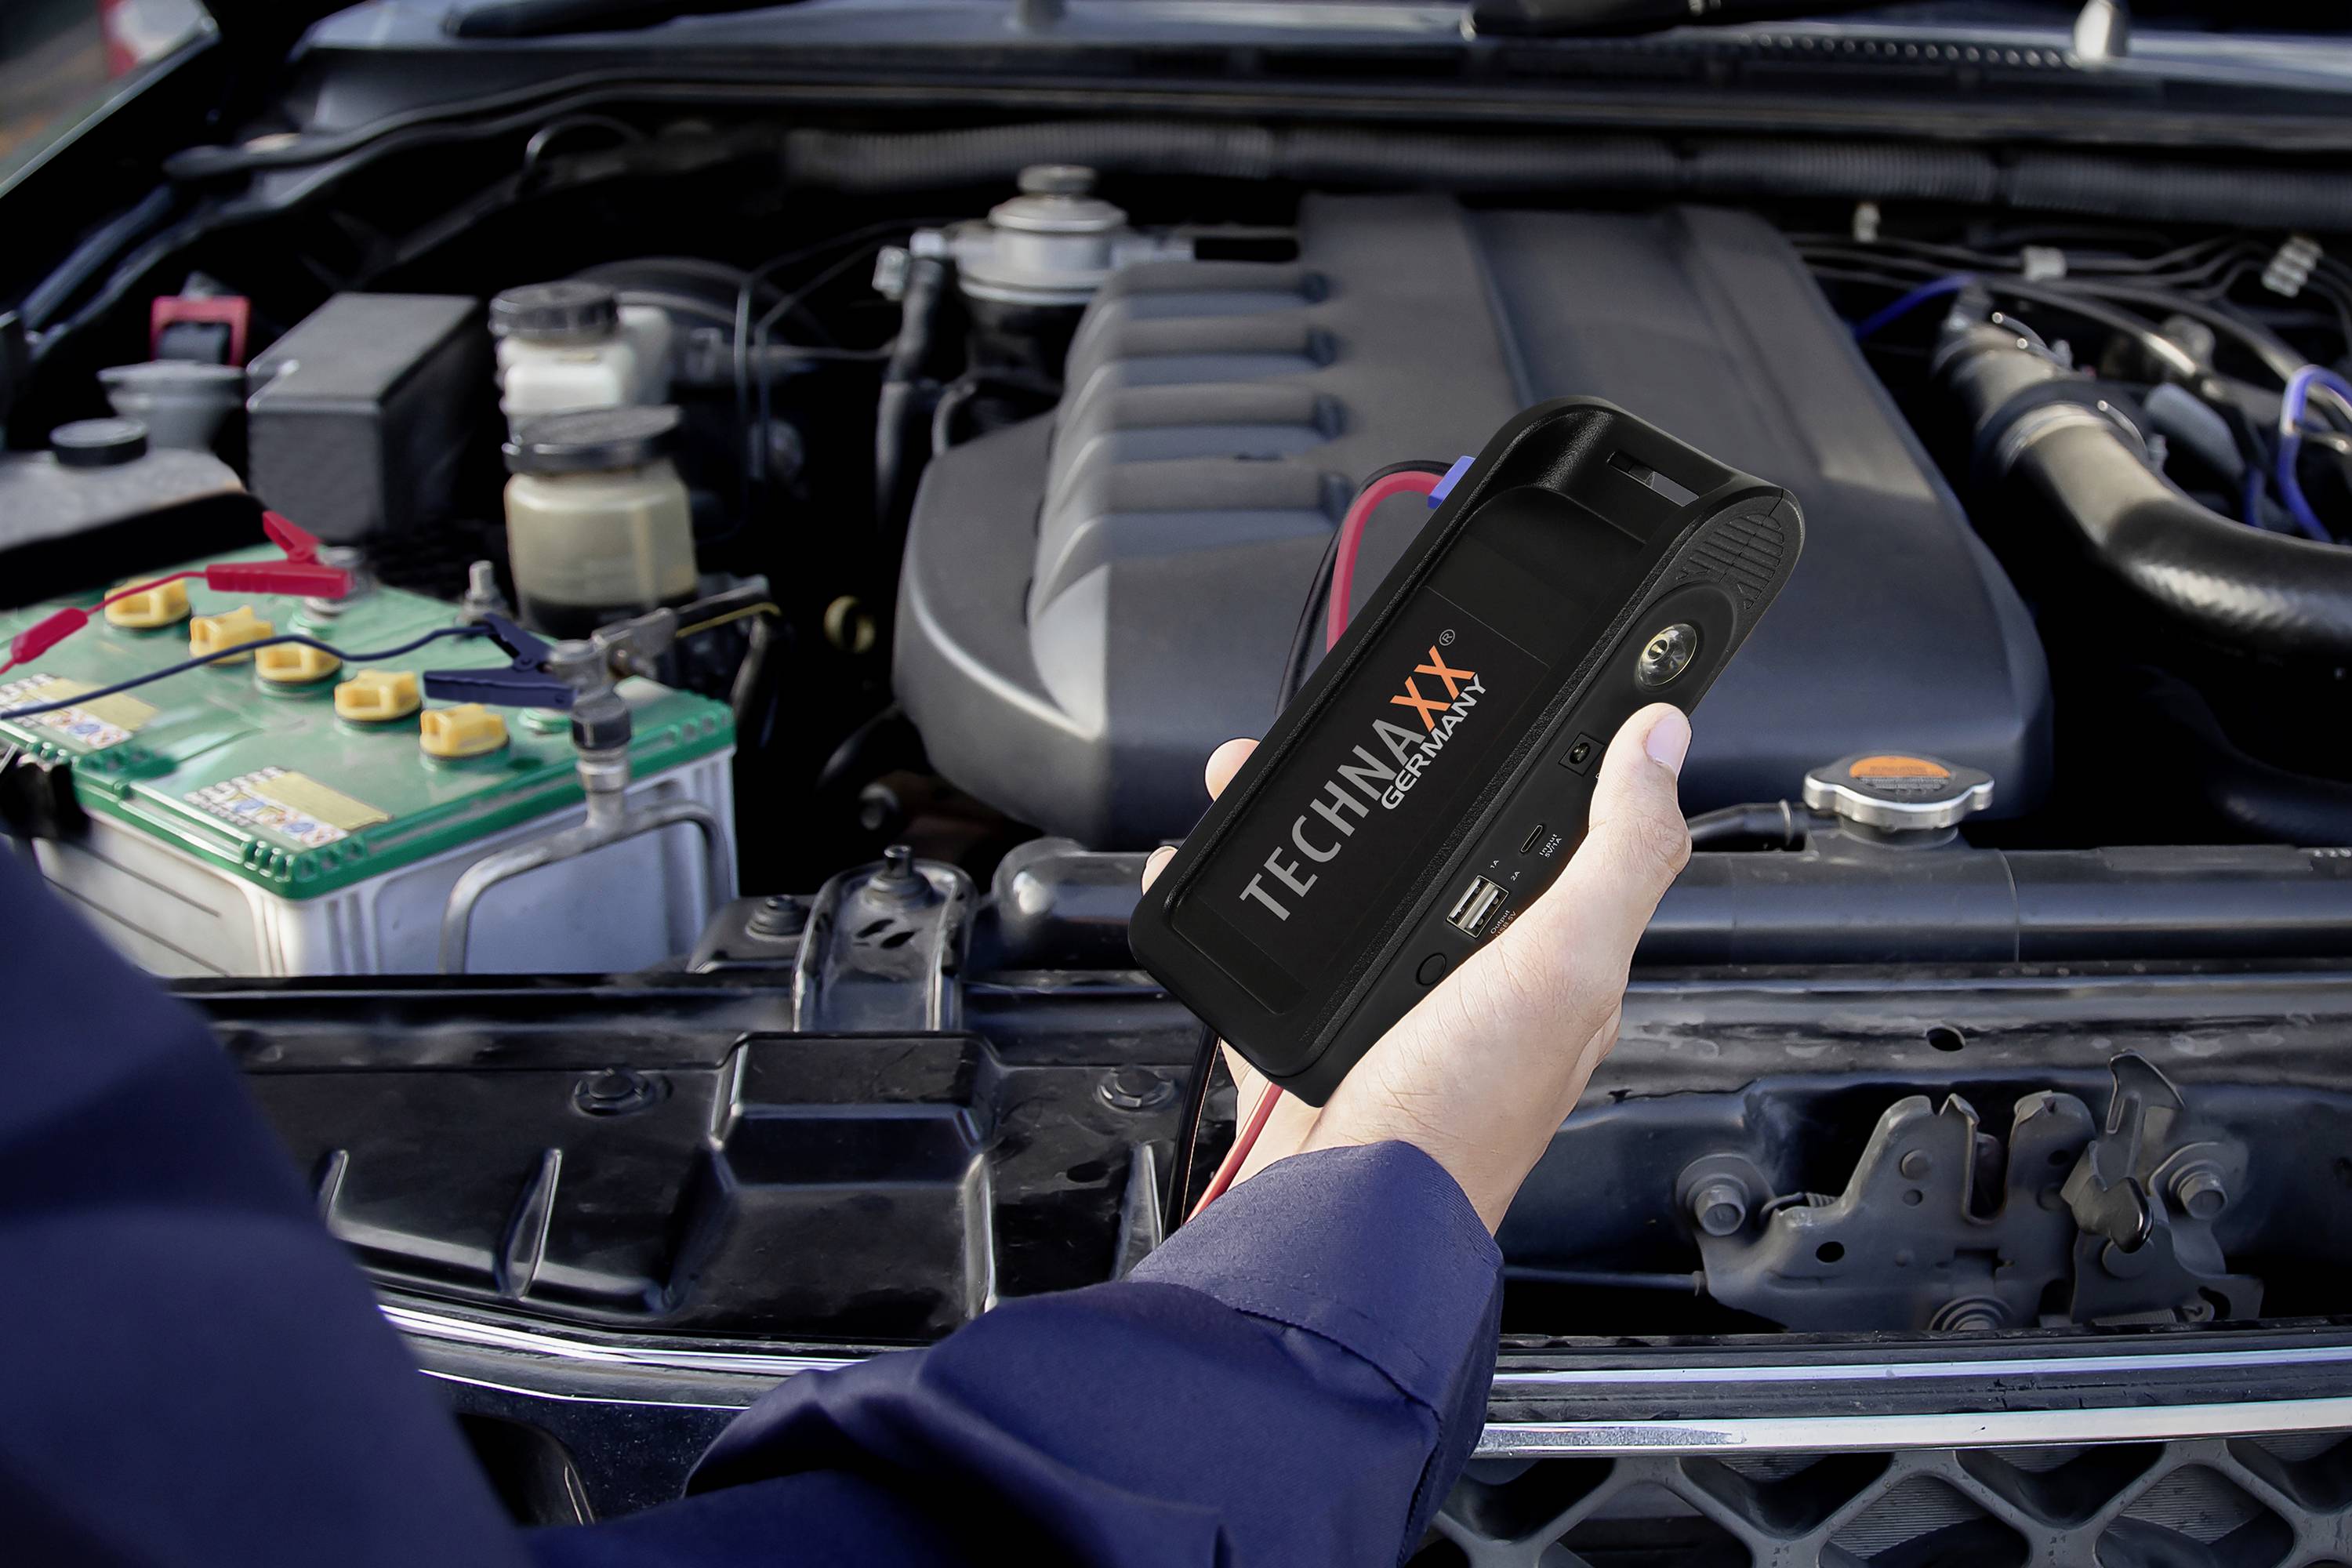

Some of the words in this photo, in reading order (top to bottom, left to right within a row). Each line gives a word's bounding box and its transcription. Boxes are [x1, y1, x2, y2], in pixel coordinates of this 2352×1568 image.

[1381, 673, 1486, 810] GERMANY
[1538, 833, 1558, 855] Input
[1544, 838, 1563, 858] 5V/1A
[1490, 859, 1499, 869] 1A
[1510, 870, 1521, 881] 2A
[1490, 909, 1511, 935] Output
